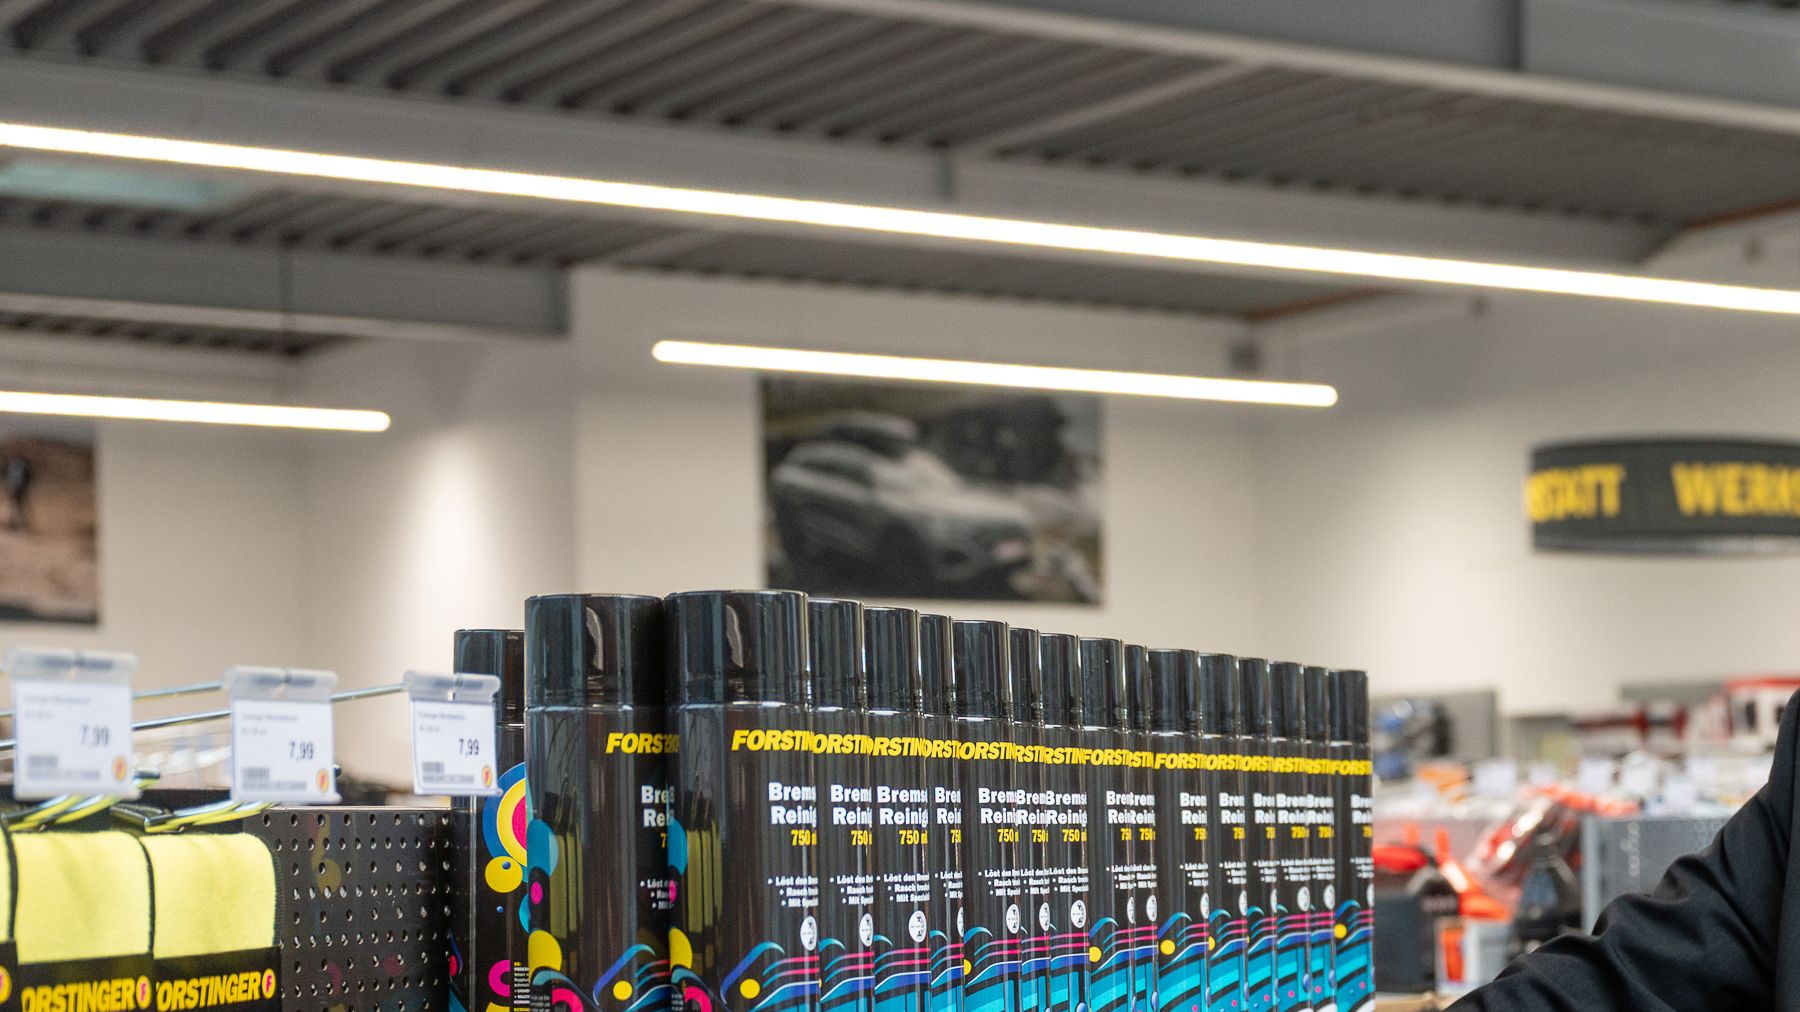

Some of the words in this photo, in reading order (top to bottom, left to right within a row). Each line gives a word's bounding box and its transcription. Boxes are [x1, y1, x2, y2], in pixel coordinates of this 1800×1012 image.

[80, 723, 110, 748] 7,99
[289, 740, 314, 762] 7,99
[459, 738, 479, 758] 7,99
[791, 829, 811, 847] 750
[851, 829, 868, 846] 750
[899, 829, 919, 846] 750
[997, 828, 1014, 843] 750
[1062, 828, 1080, 843] 750
[155, 970, 262, 1012] ORSTINGER
